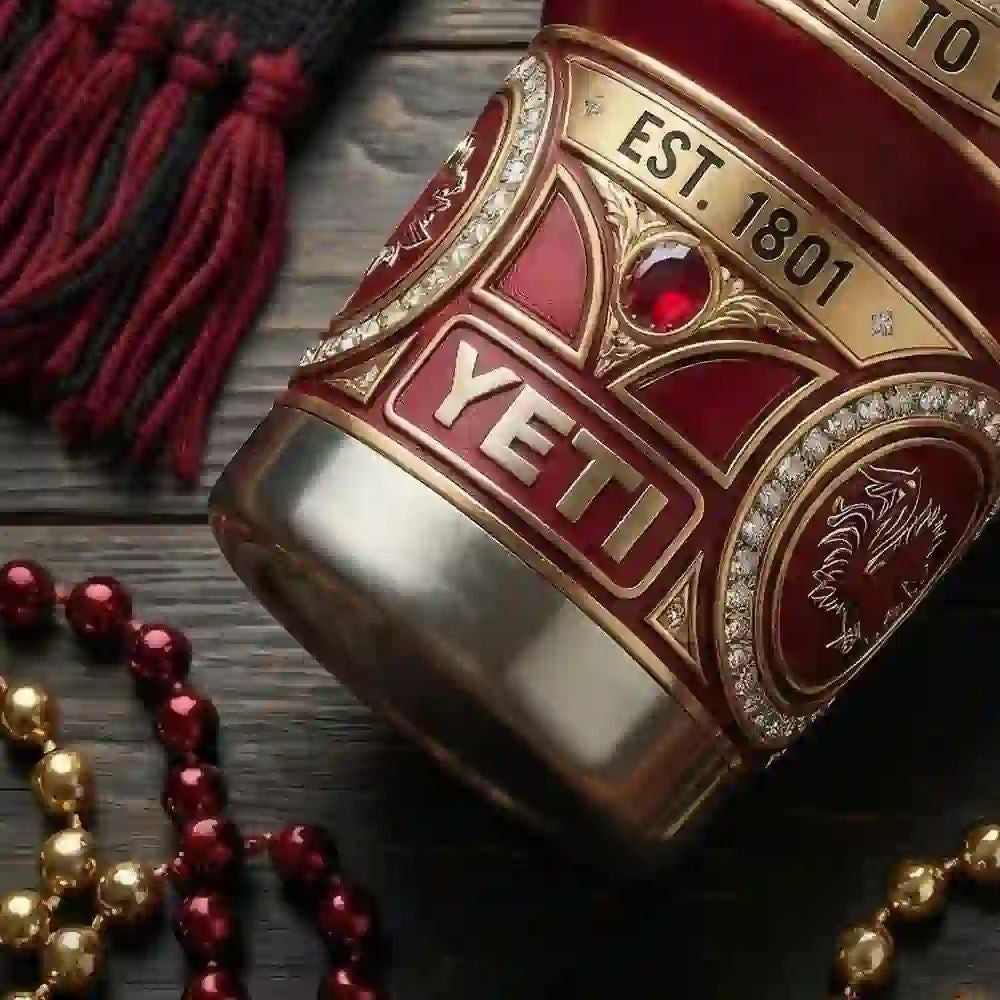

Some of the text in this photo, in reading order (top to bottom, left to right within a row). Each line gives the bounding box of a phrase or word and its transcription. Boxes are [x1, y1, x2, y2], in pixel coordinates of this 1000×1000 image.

[616, 110, 855, 306] EST. 1801
[433, 339, 669, 564] YETI
